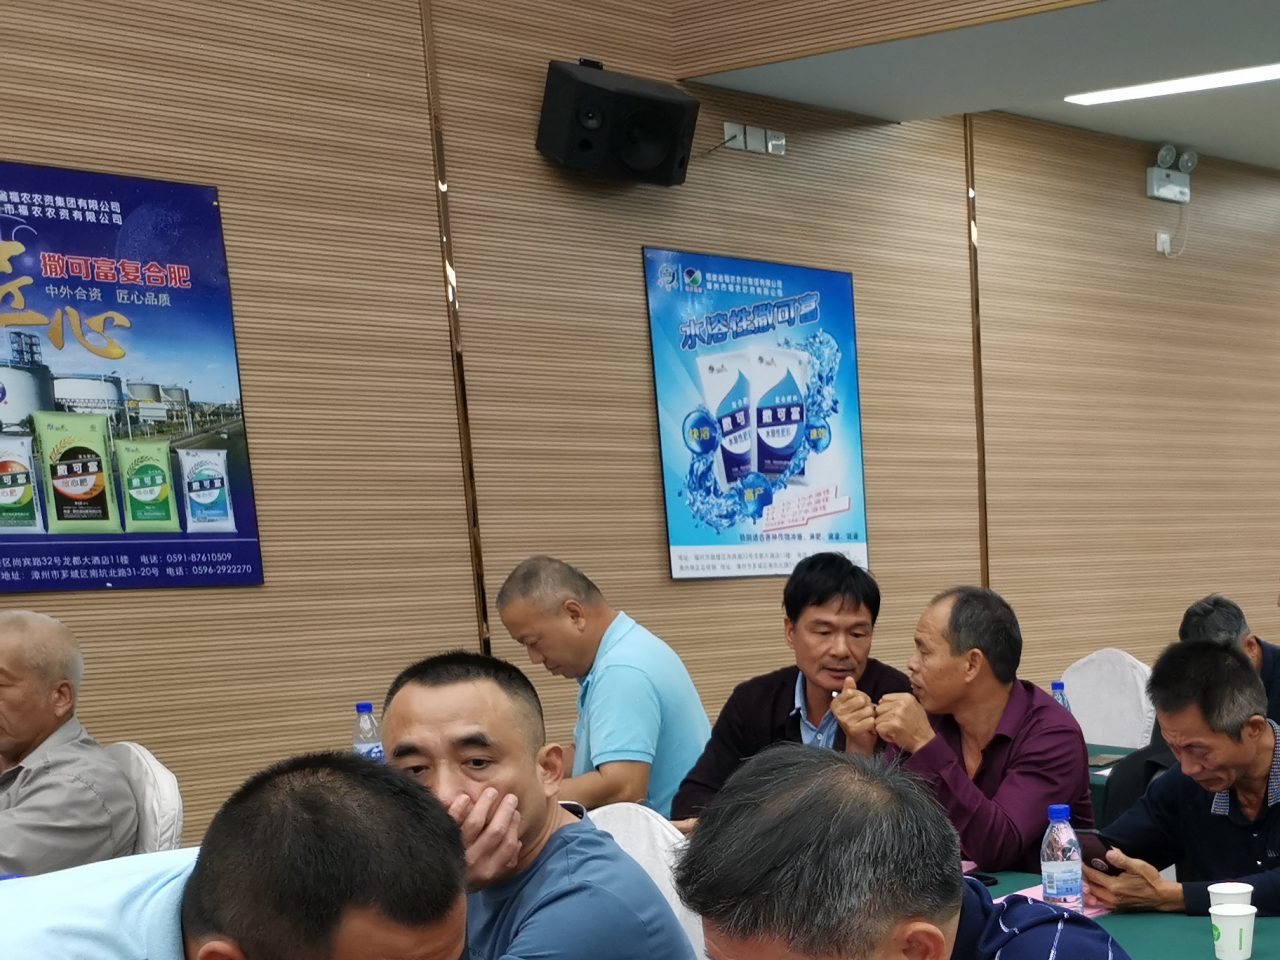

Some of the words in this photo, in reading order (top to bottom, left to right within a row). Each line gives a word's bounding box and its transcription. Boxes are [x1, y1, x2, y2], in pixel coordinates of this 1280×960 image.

[40, 252, 192, 288] 撒可富复合肥
[45, 284, 103, 302] 中外合资
[116, 290, 171, 307] 匠心品质
[0, 554, 129, 568] 区尚宾路32号龙都大酒店11楼
[166, 552, 232, 563] 0591-87610509
[192, 565, 252, 575] 0596-2922270
